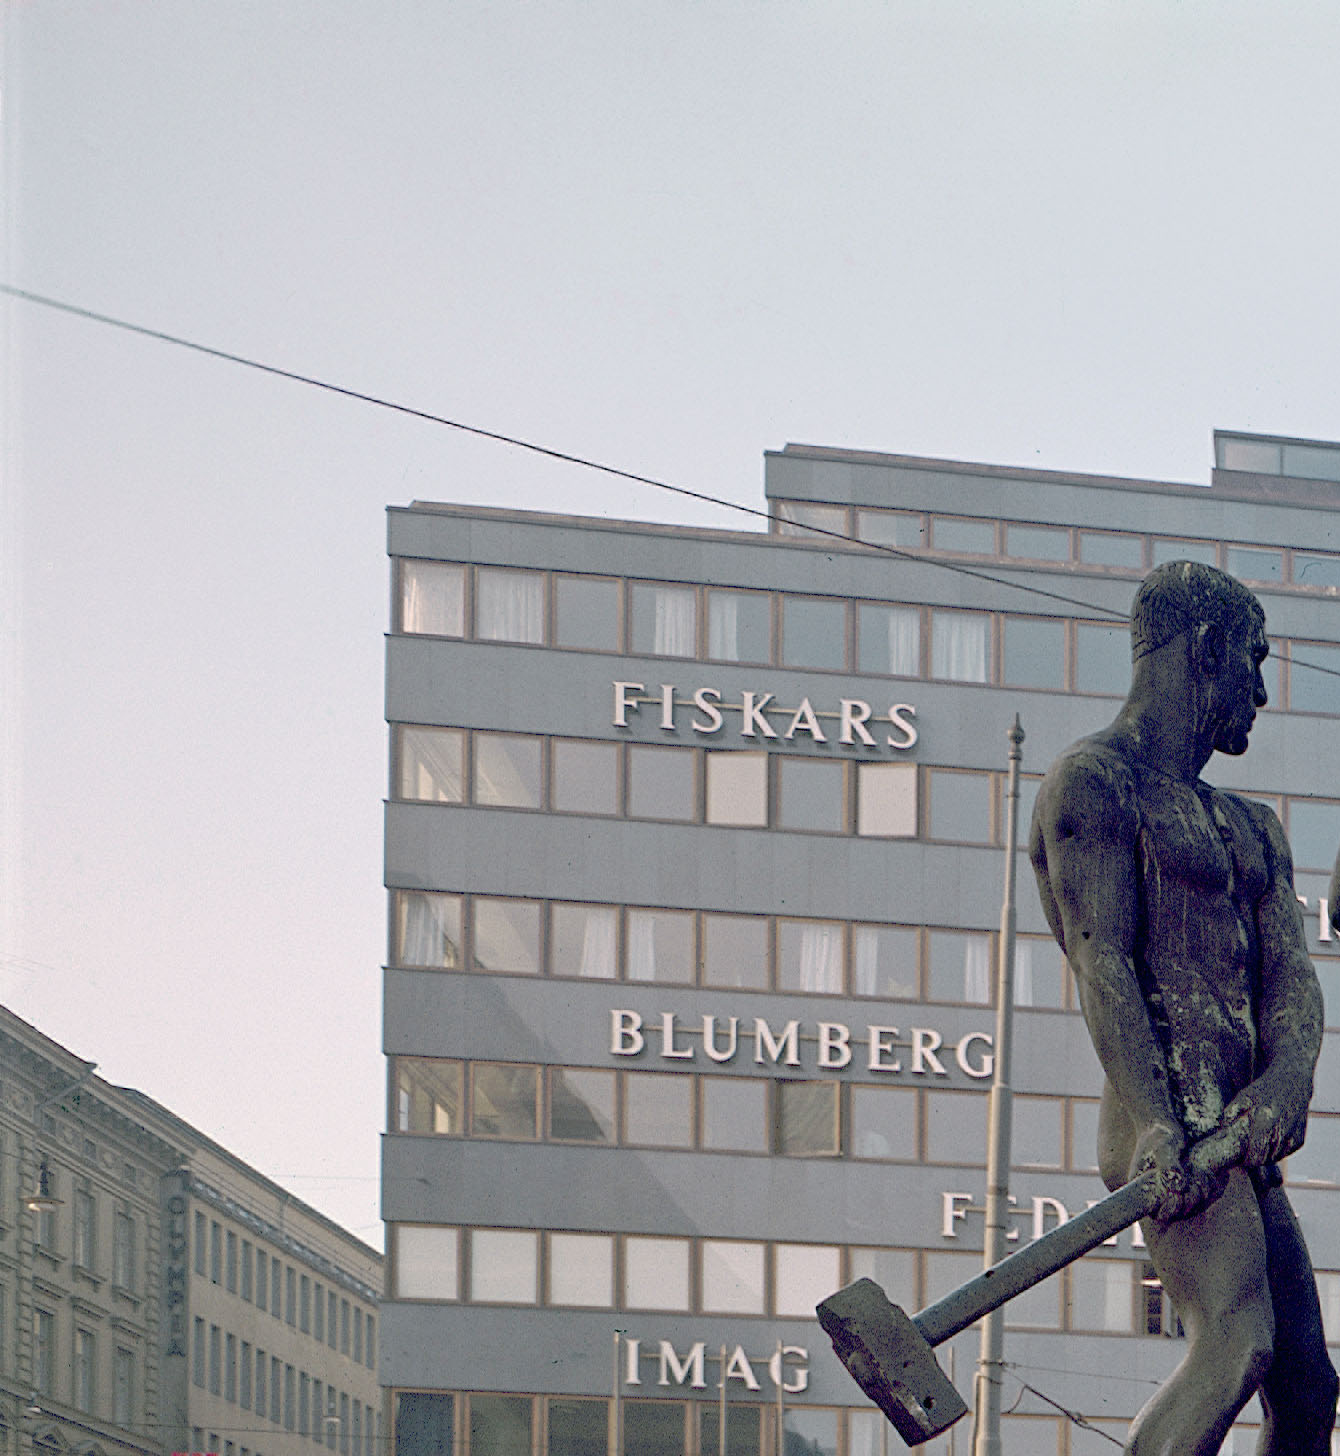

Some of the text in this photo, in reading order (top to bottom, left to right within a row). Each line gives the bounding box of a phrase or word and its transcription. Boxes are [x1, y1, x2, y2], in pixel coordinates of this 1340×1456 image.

[612, 681, 918, 749] FISKARS
[609, 1009, 994, 1078] BLUMBERG
[625, 1339, 809, 1394] IMAG
